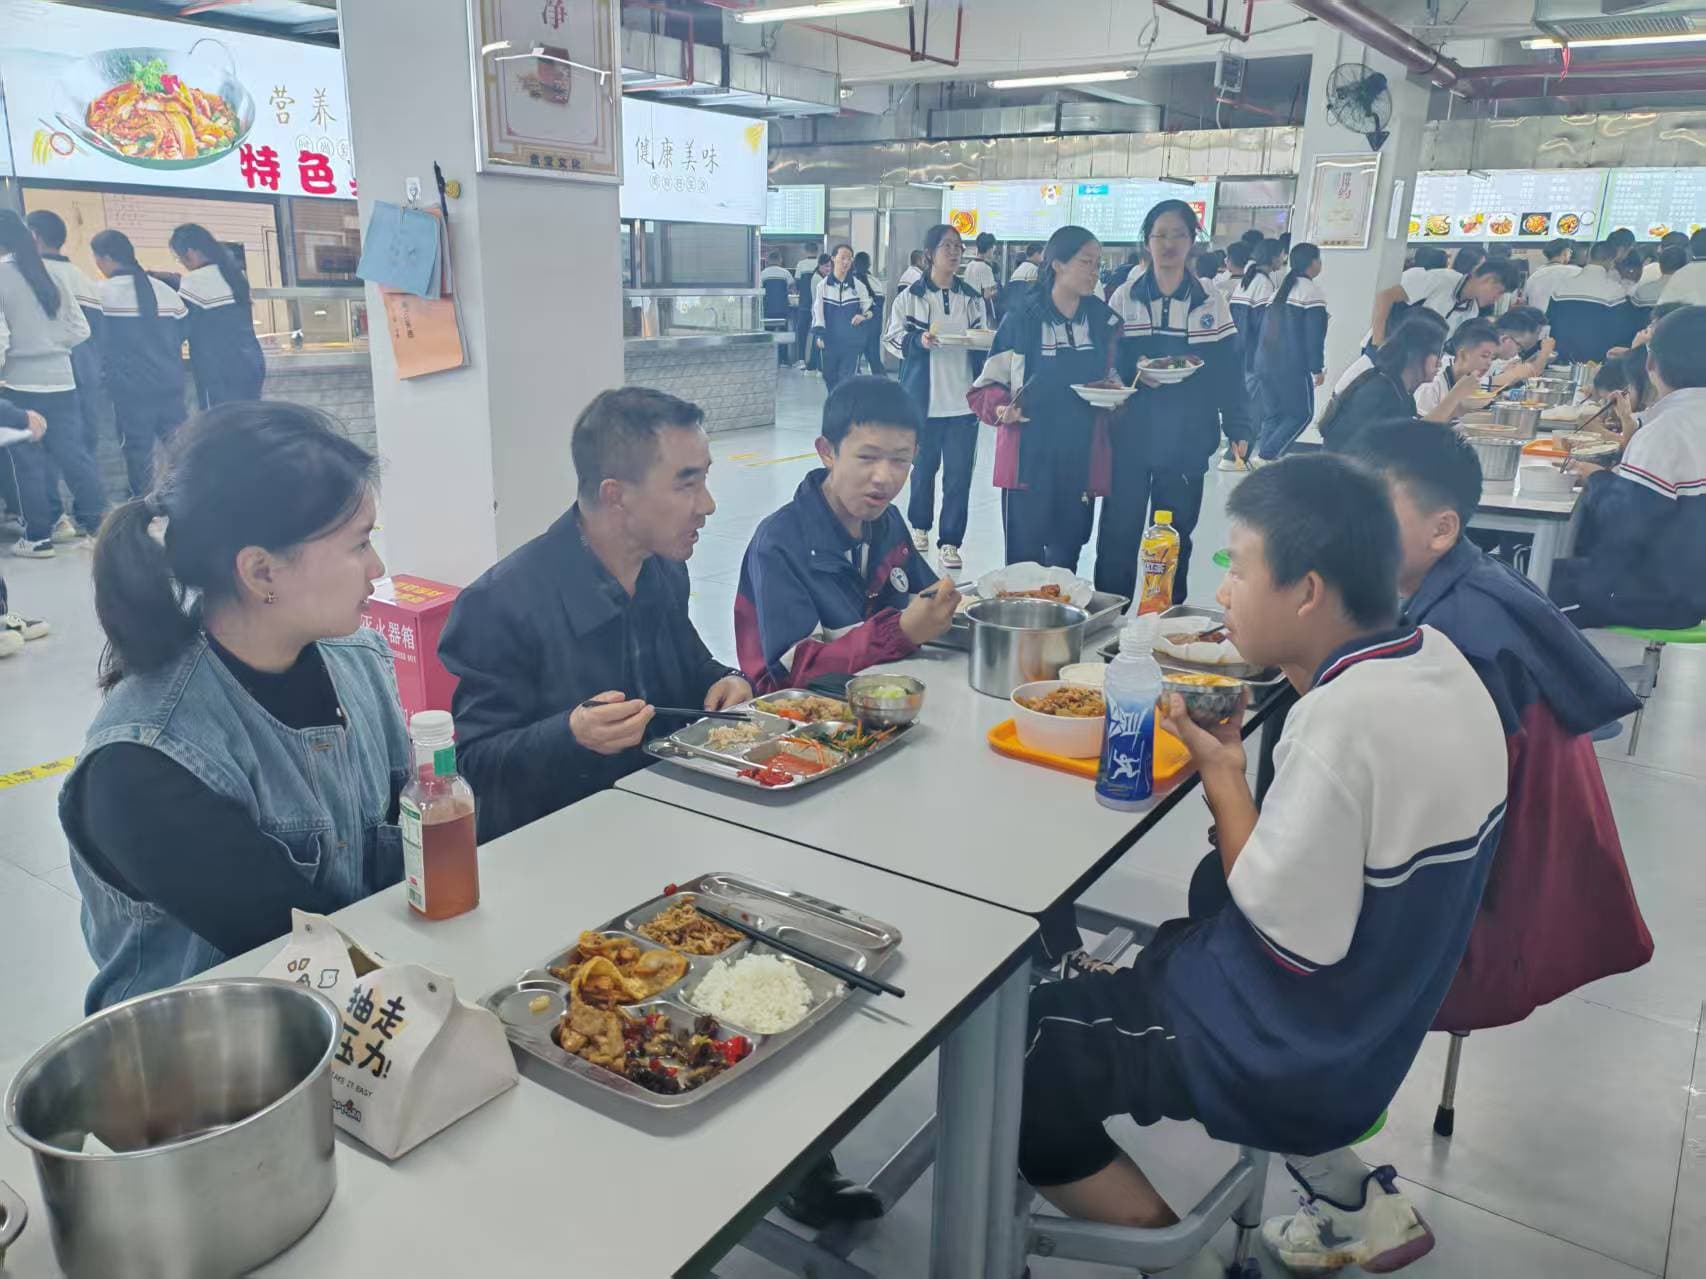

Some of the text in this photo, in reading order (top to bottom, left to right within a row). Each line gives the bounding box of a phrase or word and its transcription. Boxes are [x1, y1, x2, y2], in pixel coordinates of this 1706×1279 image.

[269, 85, 337, 132] 营养
[239, 143, 357, 196] 特色
[634, 136, 720, 174] 健康美味
[346, 984, 405, 1040] 抽走
